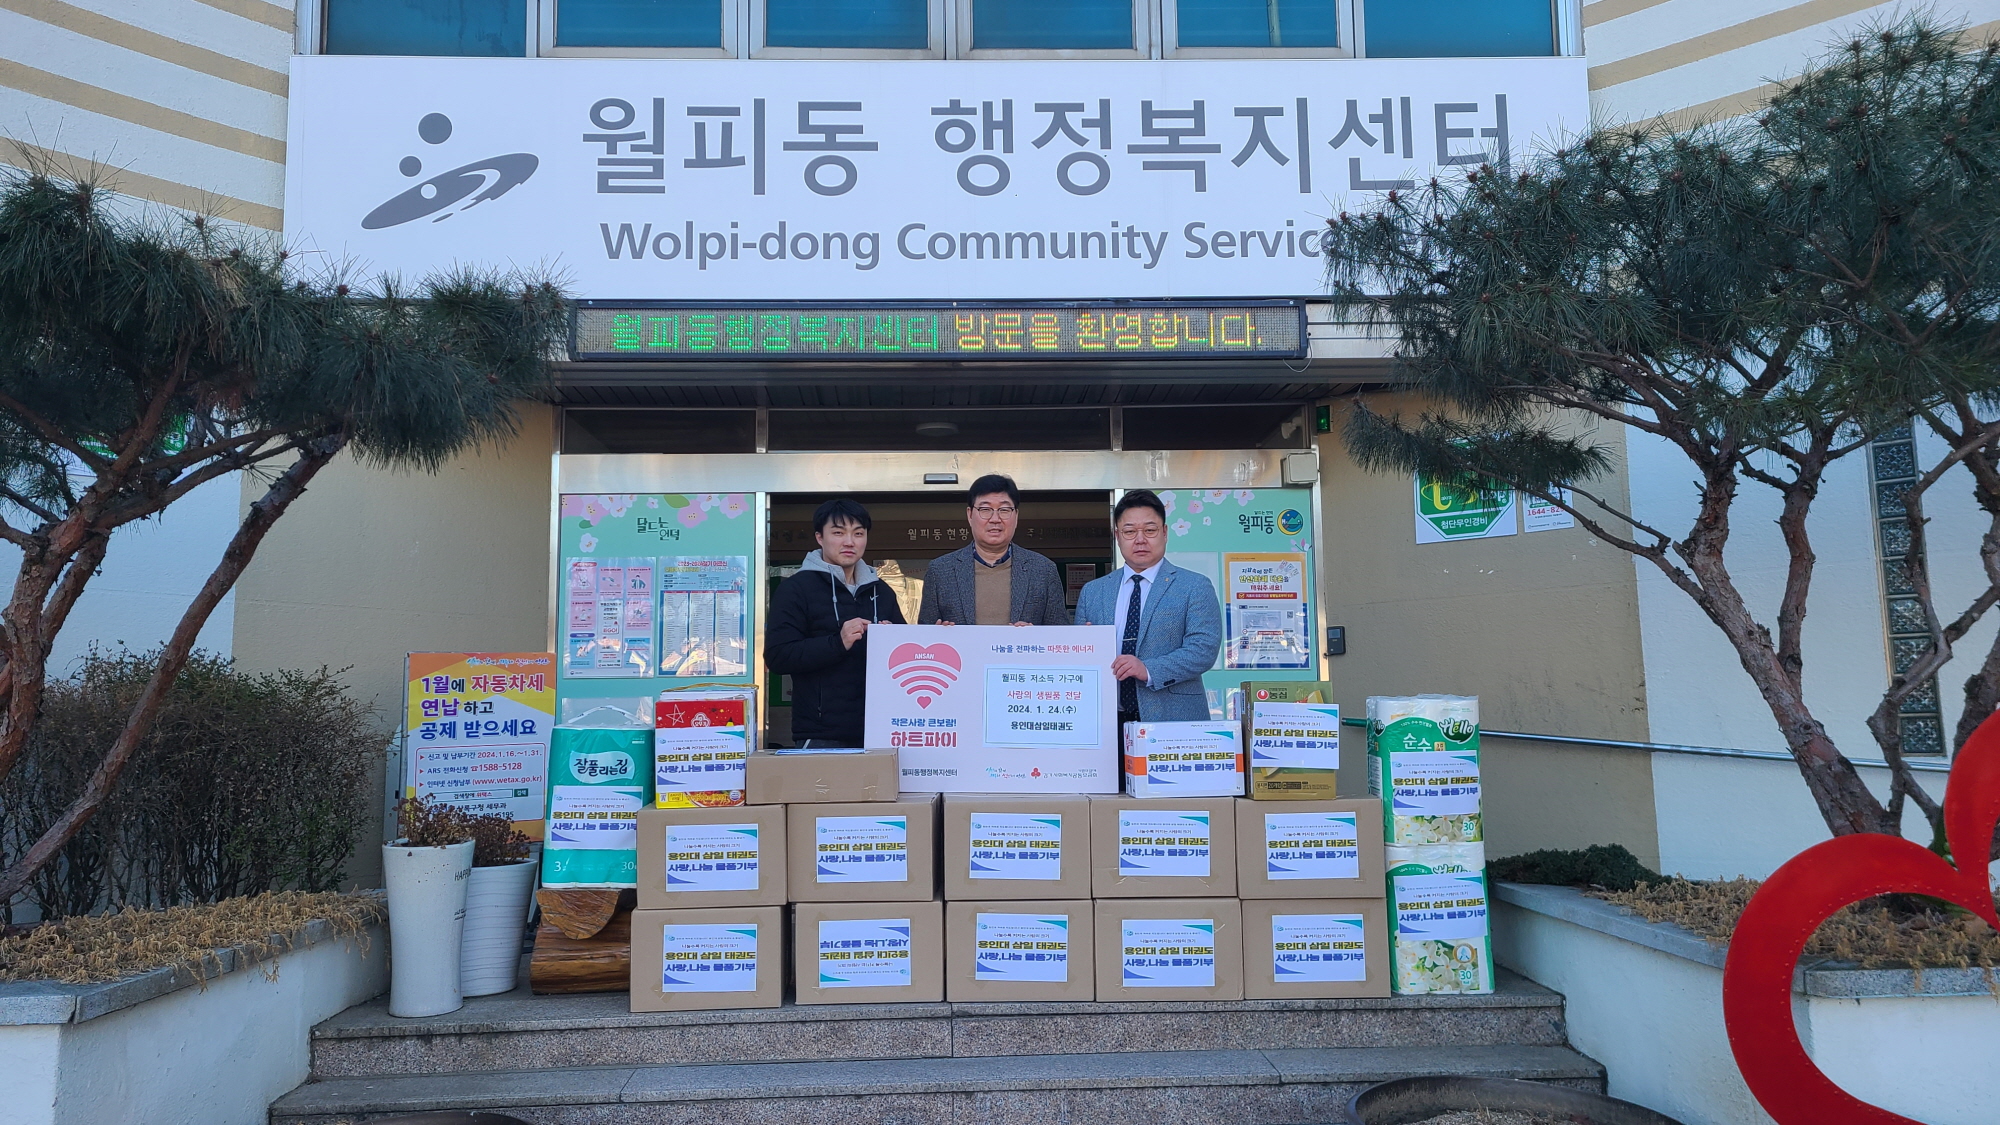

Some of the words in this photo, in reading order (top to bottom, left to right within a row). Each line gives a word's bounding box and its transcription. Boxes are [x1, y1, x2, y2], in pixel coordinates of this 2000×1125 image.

[582, 97, 879, 196] 월피동
[930, 93, 1510, 196] 행정복지센터
[600, 222, 880, 271] Wolpi-dong
[897, 220, 1168, 269] Community
[609, 313, 939, 351] 월피동행정복지센터
[954, 313, 1061, 351] 방문을
[1075, 313, 1262, 352] 환영합니다.
[636, 516, 669, 534] 달드는
[659, 529, 680, 541] 언덕
[1238, 514, 1275, 534] 월피동
[1440, 516, 1488, 530] 첨단무인경비
[907, 528, 943, 541] 월피동
[991, 644, 1013, 653] 나눔을
[1015, 644, 1045, 654] 전파하는
[1047, 644, 1070, 653] 따뜻한
[1071, 644, 1095, 653] 에너지
[914, 652, 935, 660] ANSAN
[421, 675, 465, 694] 1월에
[471, 673, 545, 693] 자동차세
[1001, 673, 1026, 684] 월피동
[1030, 674, 1055, 684] 저소득
[1058, 674, 1084, 684] 가구에
[1007, 690, 1033, 700] 사랑의
[1036, 690, 1061, 701] 생필품
[1065, 690, 1082, 701] 전달
[1269, 691, 1287, 700] 농심
[420, 698, 460, 717] 연납
[463, 701, 494, 715] 하고
[1007, 704, 1033, 714] 2024.
[1037, 704, 1045, 714] 1.
[1048, 704, 1077, 715] 24.(수)
[890, 717, 925, 727] 작은사랑
[928, 717, 957, 727] 큰보람!
[1010, 721, 1074, 731] 용인대삼일태권도
[1439, 717, 1474, 736] Hello
[419, 720, 457, 740] 공제
[464, 719, 537, 739] 받으세요
[1254, 729, 1283, 738] 용인대
[1286, 729, 1306, 738] 삼일
[1309, 730, 1338, 739] 태권도
[890, 731, 957, 748] 하트파이
[1254, 739, 1296, 749] 사랑,나눔
[1298, 740, 1338, 750] 물품기부
[1403, 733, 1432, 752] 순수
[427, 753, 441, 761] 신고
[450, 752, 476, 760] 납부기간
[658, 753, 688, 762] 용인대
[691, 752, 711, 761] 삼일
[715, 751, 744, 760] 태권도
[1149, 754, 1179, 763] 용인대
[1183, 753, 1202, 762] 삼일
[1206, 752, 1235, 761] 태권도
[443, 766, 468, 774] 전화신청
[479, 762, 522, 771] 1588-5128
[573, 758, 628, 777] 잘풀리는집
[658, 764, 701, 774] 사랑,나눔
[704, 762, 744, 772] 물품기부
[901, 767, 958, 777] 월피동행정복지센터
[1149, 764, 1192, 774] 사랑,나눔
[1195, 763, 1235, 773] 물품기부
[427, 780, 446, 788] 인터넷
[446, 779, 471, 788] 신청납부
[472, 775, 542, 786] (www.wetax.go.kr)
[1394, 778, 1423, 787] 용인대
[1427, 777, 1446, 786] 삼일
[1449, 776, 1478, 785] 태권도
[1394, 788, 1436, 798] 사랑,나눔
[1439, 786, 1478, 796] 물품기부
[486, 802, 507, 810] 세무과
[1463, 822, 1474, 831] 30
[818, 843, 849, 852] 용인대
[852, 843, 873, 851] 삼일
[876, 842, 906, 851] 태권도
[972, 839, 1002, 848] 용인대
[1006, 840, 1026, 848] 삼일
[1030, 840, 1060, 849] 태권도
[1121, 837, 1152, 846] 용인대
[1155, 838, 1176, 846] 삼일
[1179, 838, 1209, 846] 태권도
[1268, 840, 1299, 849] 용인대
[1303, 839, 1323, 848] 삼일
[1327, 839, 1357, 848] 태권도
[668, 851, 699, 860] 용인대
[702, 851, 723, 860] 삼일
[727, 850, 757, 859] 태권도
[818, 854, 862, 864] 사랑,나눔
[865, 853, 906, 863] 물품기부
[972, 851, 1016, 860] 사랑,나눔
[1018, 851, 1060, 861] 물품기부
[1121, 848, 1165, 857] 사랑,나눔
[1168, 849, 1209, 858] 물품기부
[1268, 851, 1313, 861] 사랑,나눔
[1315, 850, 1357, 860] 물품기부
[668, 862, 713, 872] 사랑,나눔
[715, 862, 757, 871] 물품기부
[978, 941, 1009, 950] 용인대
[1012, 941, 1033, 950] 삼일
[1037, 942, 1067, 950] 태권도
[1124, 946, 1155, 955] 용인대
[1159, 946, 1180, 955] 삼일
[1183, 946, 1214, 955] 태권도
[664, 952, 696, 960] 용인대
[700, 951, 721, 960] 삼일
[725, 951, 756, 960] 태권도
[978, 952, 1023, 961] 사랑,나눔
[1025, 953, 1067, 962] 물품기부
[664, 963, 711, 972] 사랑,나눔
[713, 963, 756, 972] 물품기부
[1124, 958, 1169, 967] 사랑,나눔
[1172, 958, 1214, 967] 물품기부
[1459, 970, 1472, 980] 30
